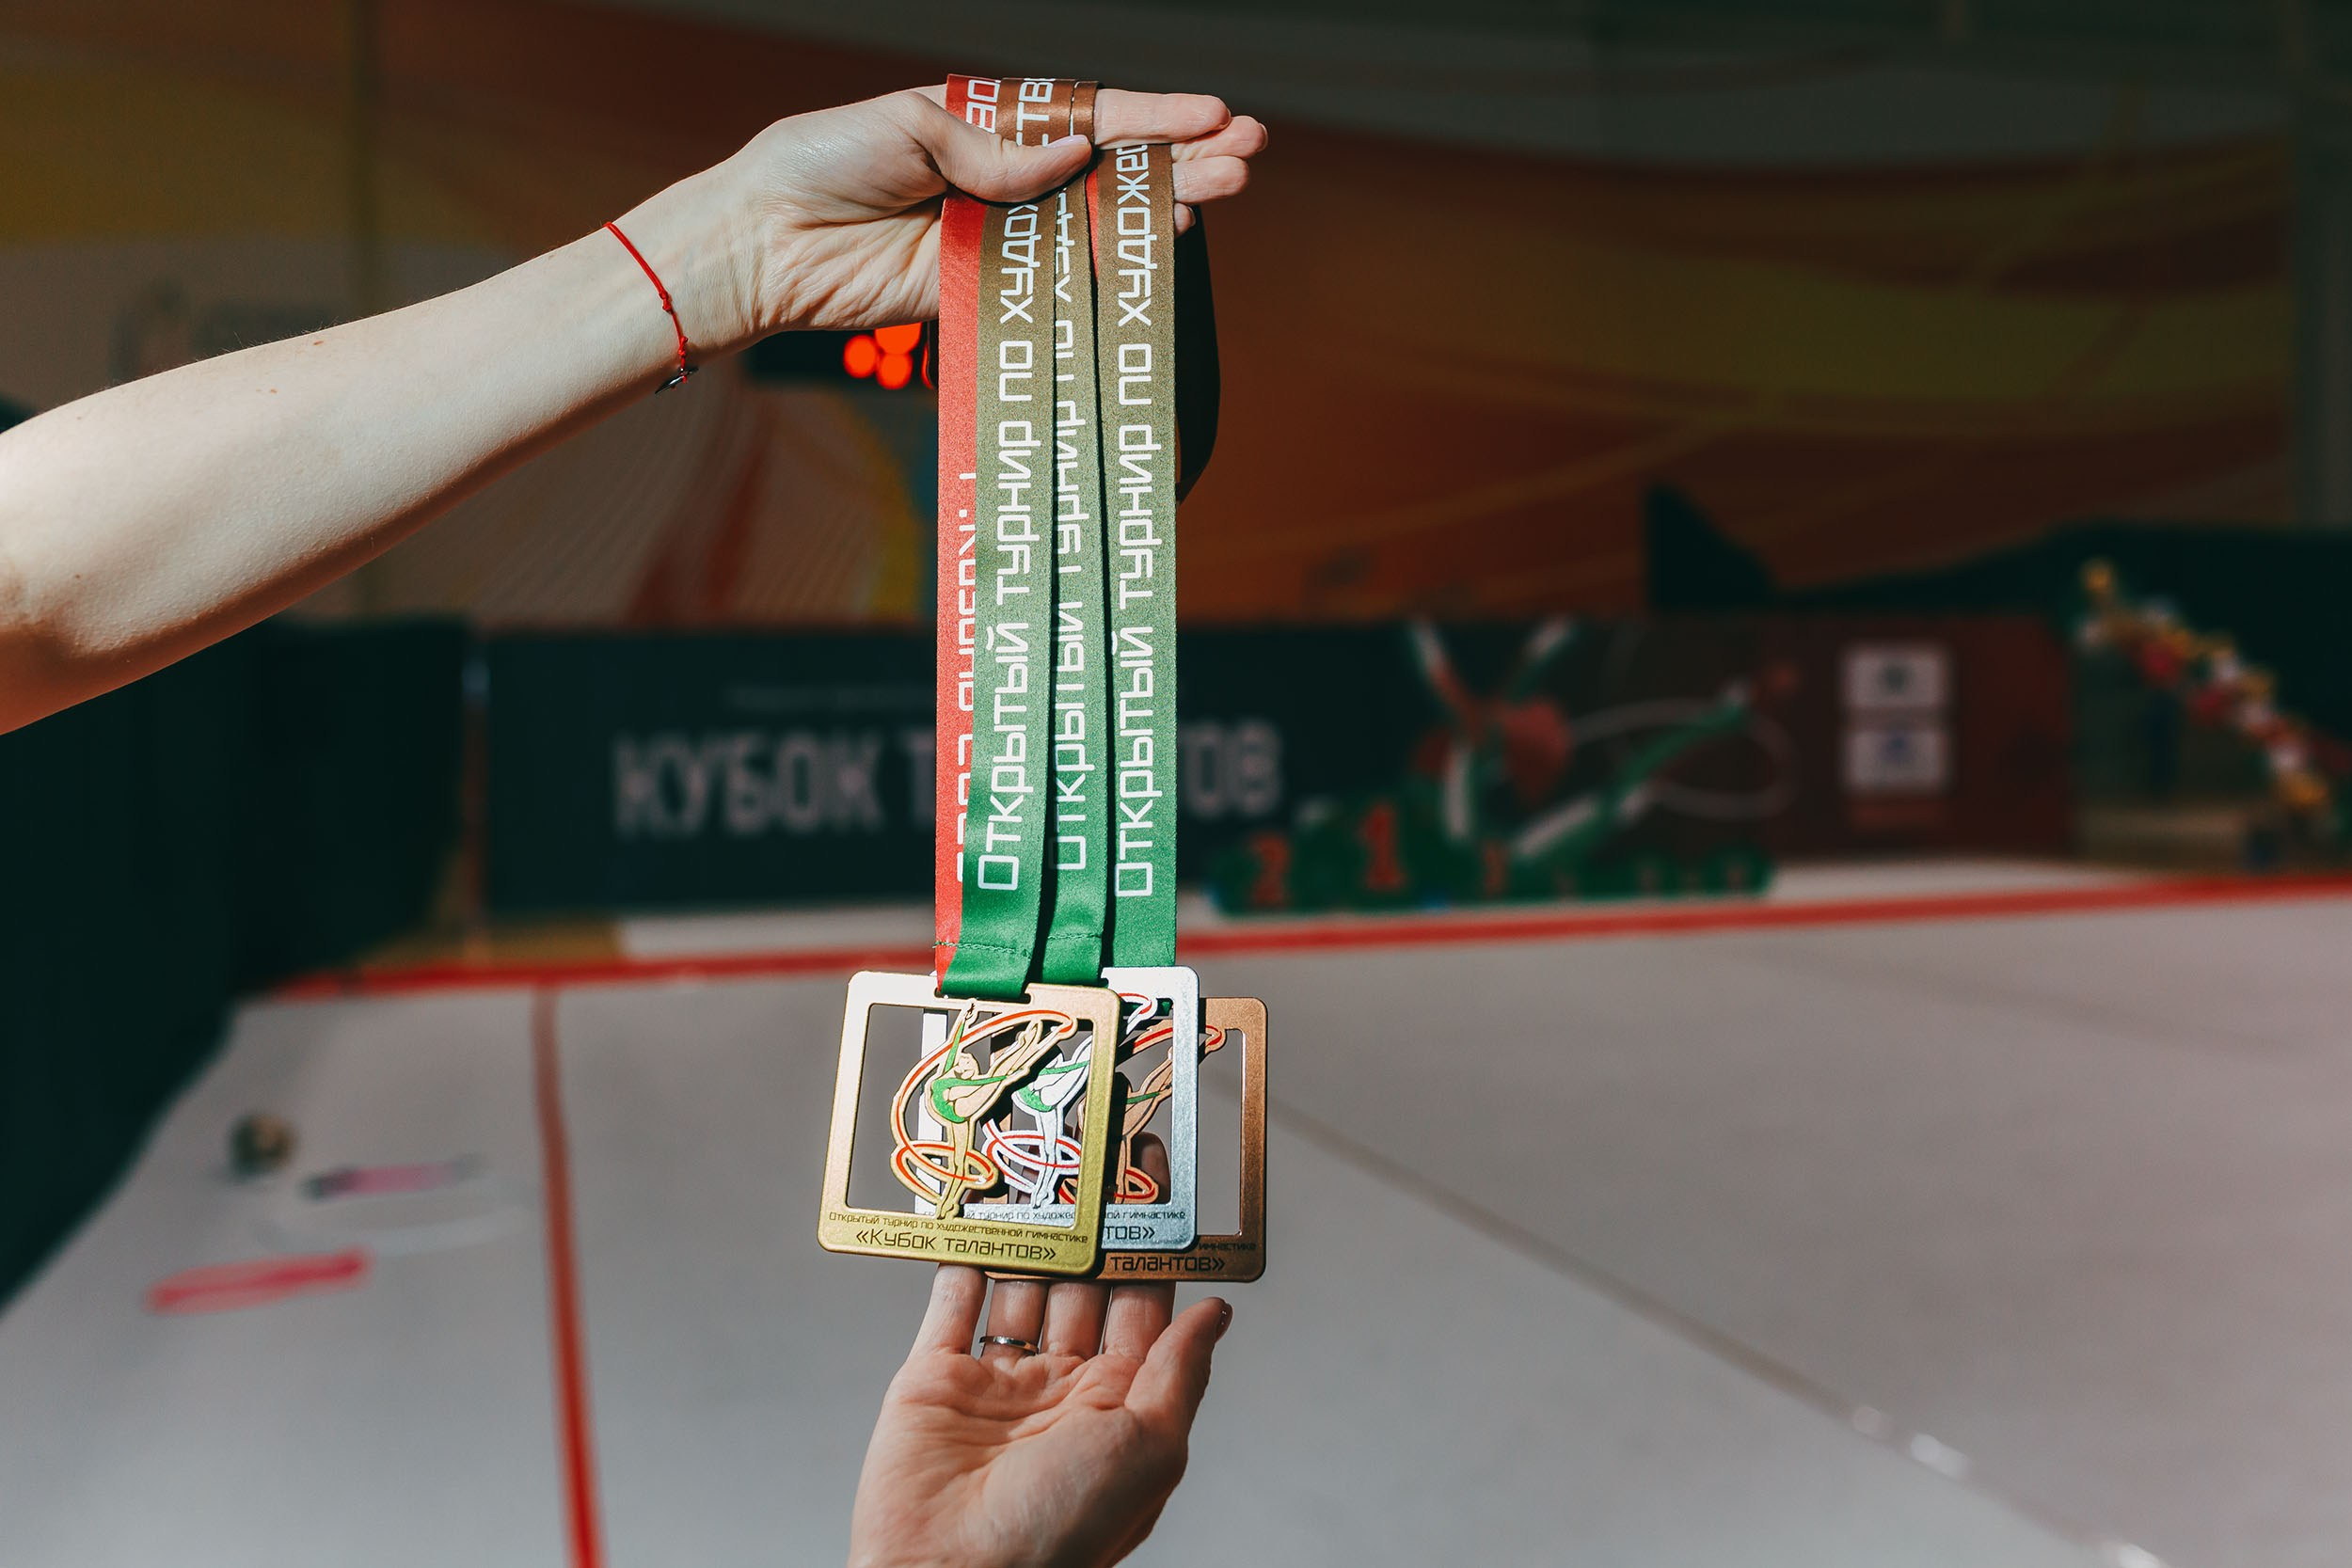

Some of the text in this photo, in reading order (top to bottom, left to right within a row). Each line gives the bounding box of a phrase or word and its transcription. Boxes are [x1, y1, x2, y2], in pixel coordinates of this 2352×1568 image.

[999, 341, 1033, 401] по
[1118, 343, 1152, 405] по
[996, 420, 1041, 605] турнир
[1119, 425, 1163, 610] турнир
[613, 726, 884, 837] КУБОК
[977, 622, 1034, 890] Открытый
[1112, 626, 1163, 896] Открытый
[829, 1212, 1089, 1243] Открытый турнир по художественной гимнастике
[856, 1228, 1057, 1260] «Кубок талантов»
